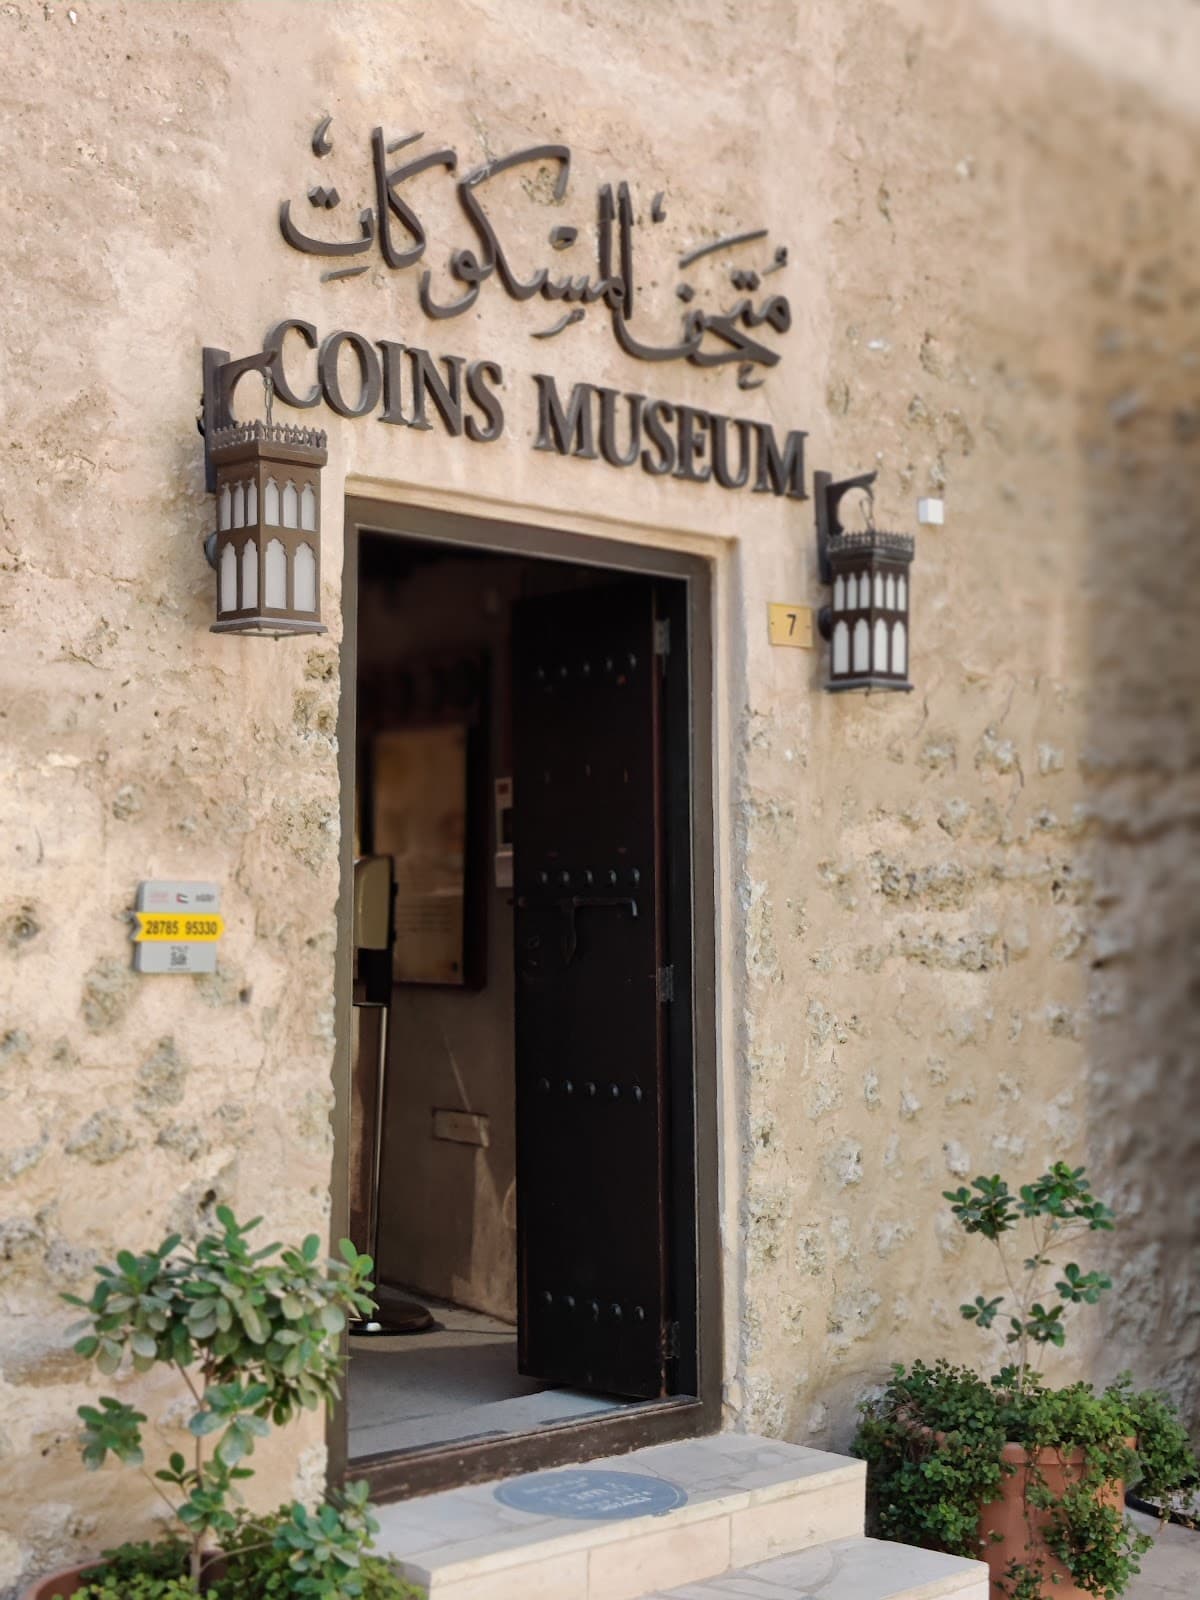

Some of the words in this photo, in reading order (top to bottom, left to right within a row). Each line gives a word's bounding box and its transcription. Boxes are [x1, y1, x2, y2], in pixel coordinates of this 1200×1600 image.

[263, 319, 504, 442] COINS
[533, 373, 809, 500] MUSEUM
[786, 613, 797, 637] 7
[145, 920, 179, 936] 28785
[185, 921, 217, 936] 95330
